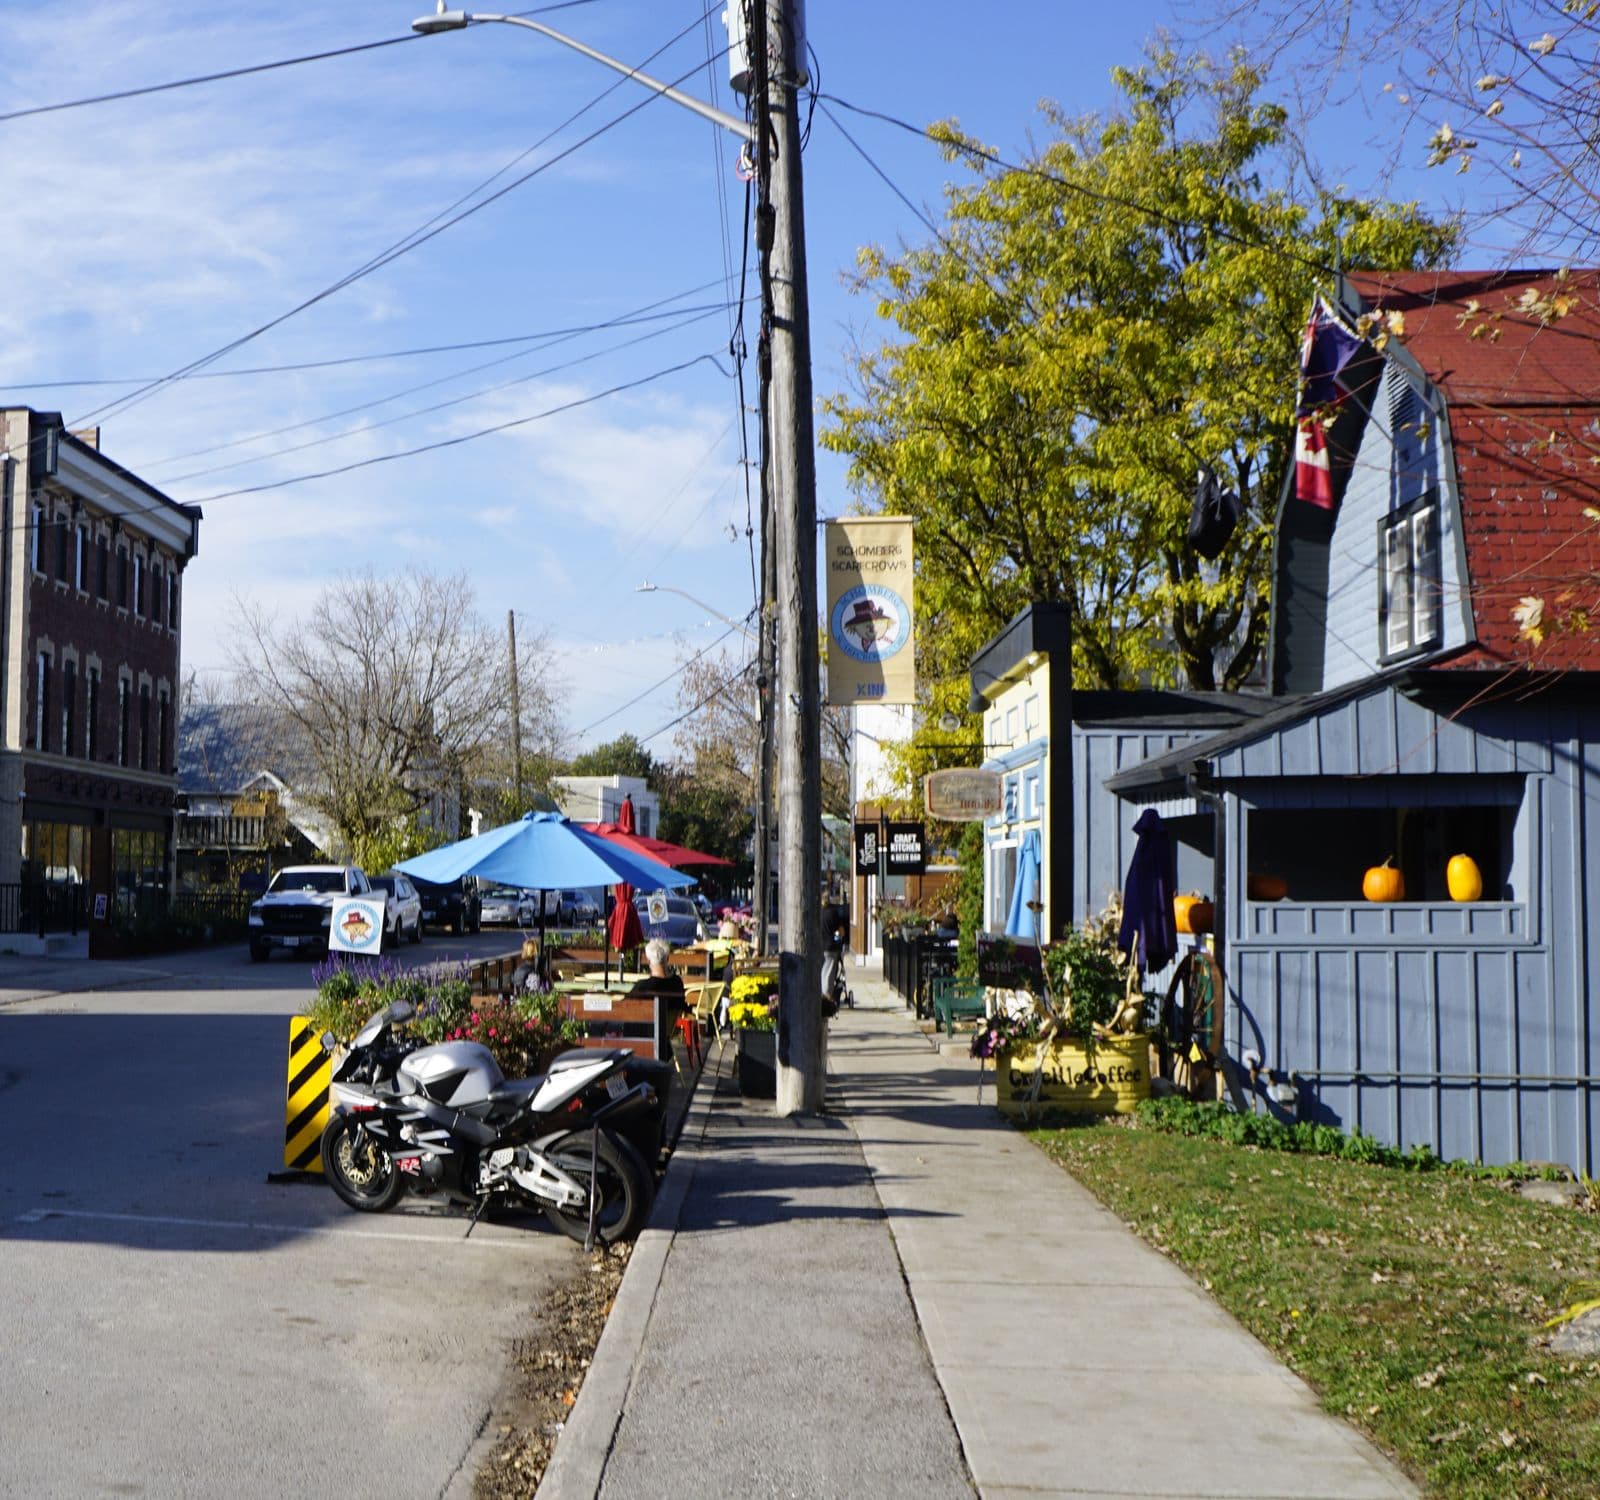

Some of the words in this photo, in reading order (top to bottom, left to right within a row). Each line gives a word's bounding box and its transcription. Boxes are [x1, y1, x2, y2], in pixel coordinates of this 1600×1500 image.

[836, 544, 902, 556] SCHOMBERG
[832, 560, 907, 572] SCARECROWS
[894, 833, 917, 843] CRAFT
[890, 842, 921, 853] KITCHEN
